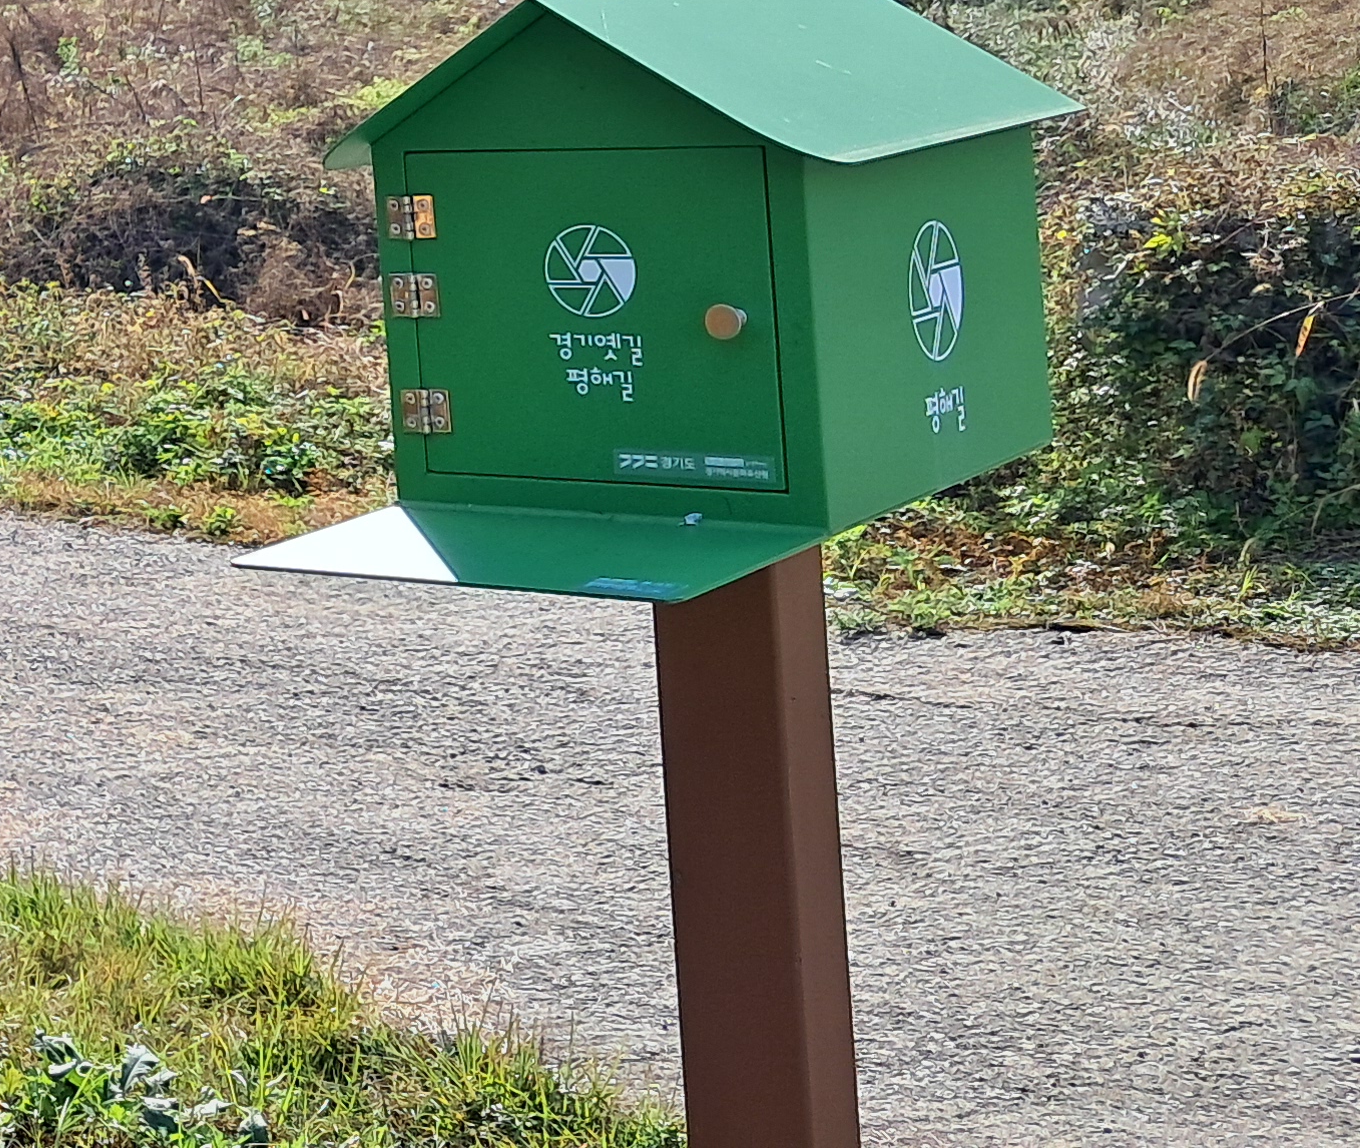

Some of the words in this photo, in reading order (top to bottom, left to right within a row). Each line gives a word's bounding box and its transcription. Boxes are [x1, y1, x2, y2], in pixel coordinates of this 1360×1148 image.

[549, 332, 643, 367] 경기옛길
[566, 367, 634, 402] 평해길
[924, 385, 966, 434] 평해길
[660, 456, 696, 470] 경기도
